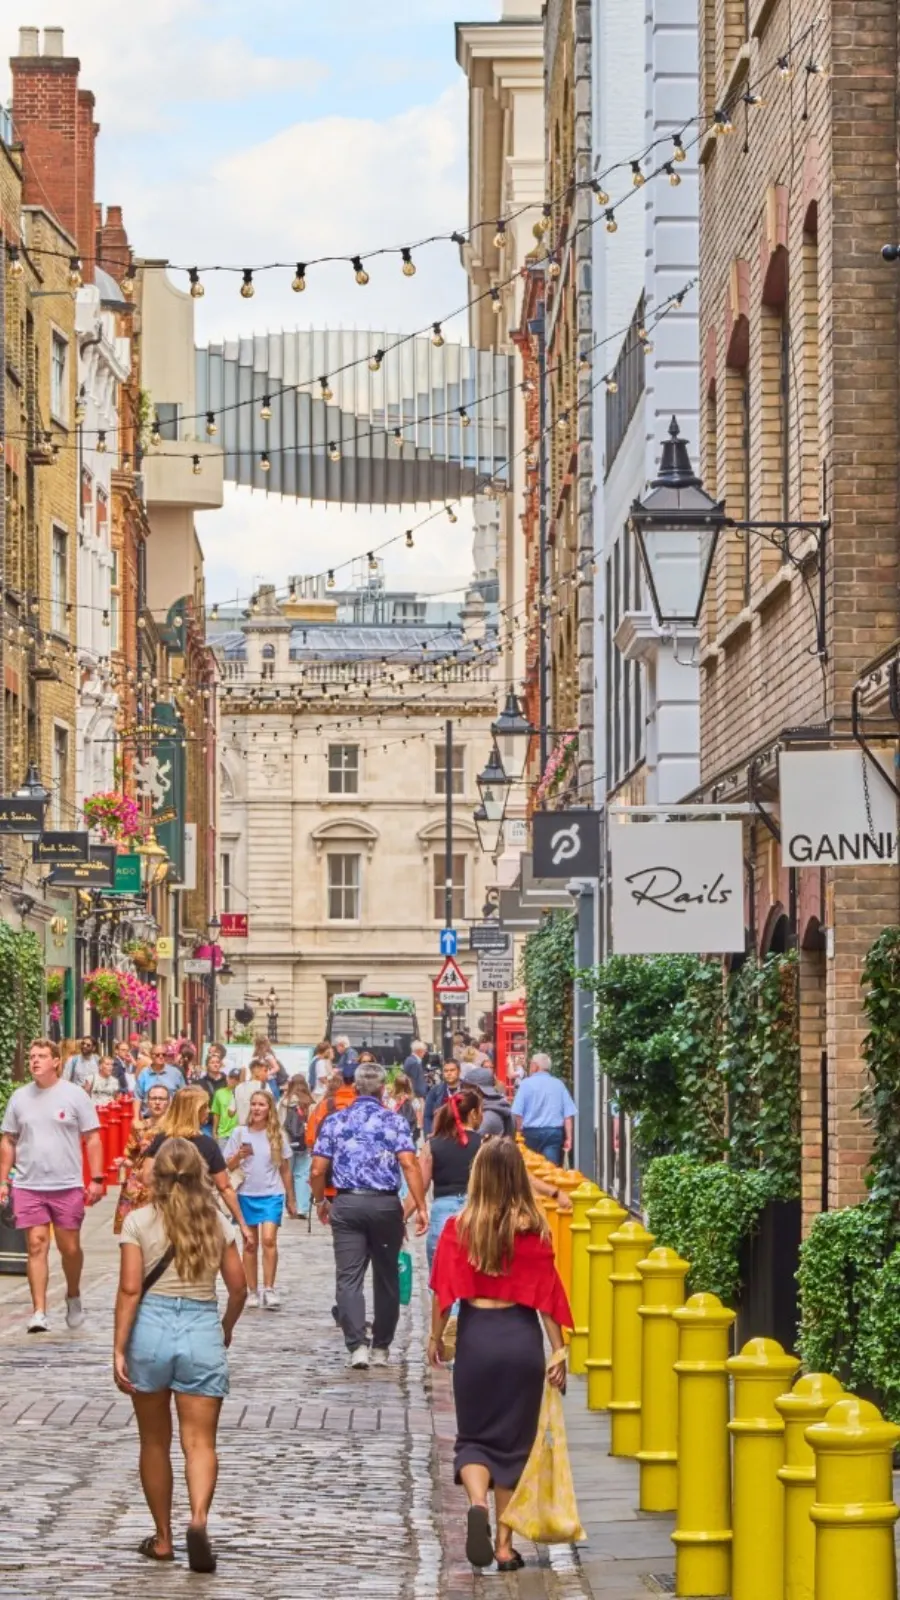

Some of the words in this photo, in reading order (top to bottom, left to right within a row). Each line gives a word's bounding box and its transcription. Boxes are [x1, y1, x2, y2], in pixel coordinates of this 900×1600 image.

[11, 811, 37, 821] Smith
[39, 843, 57, 852] Paul
[58, 843, 82, 852] Smith
[789, 832, 893, 862] GANNI
[625, 866, 732, 913] Rails
[482, 981, 510, 989] ENDS
